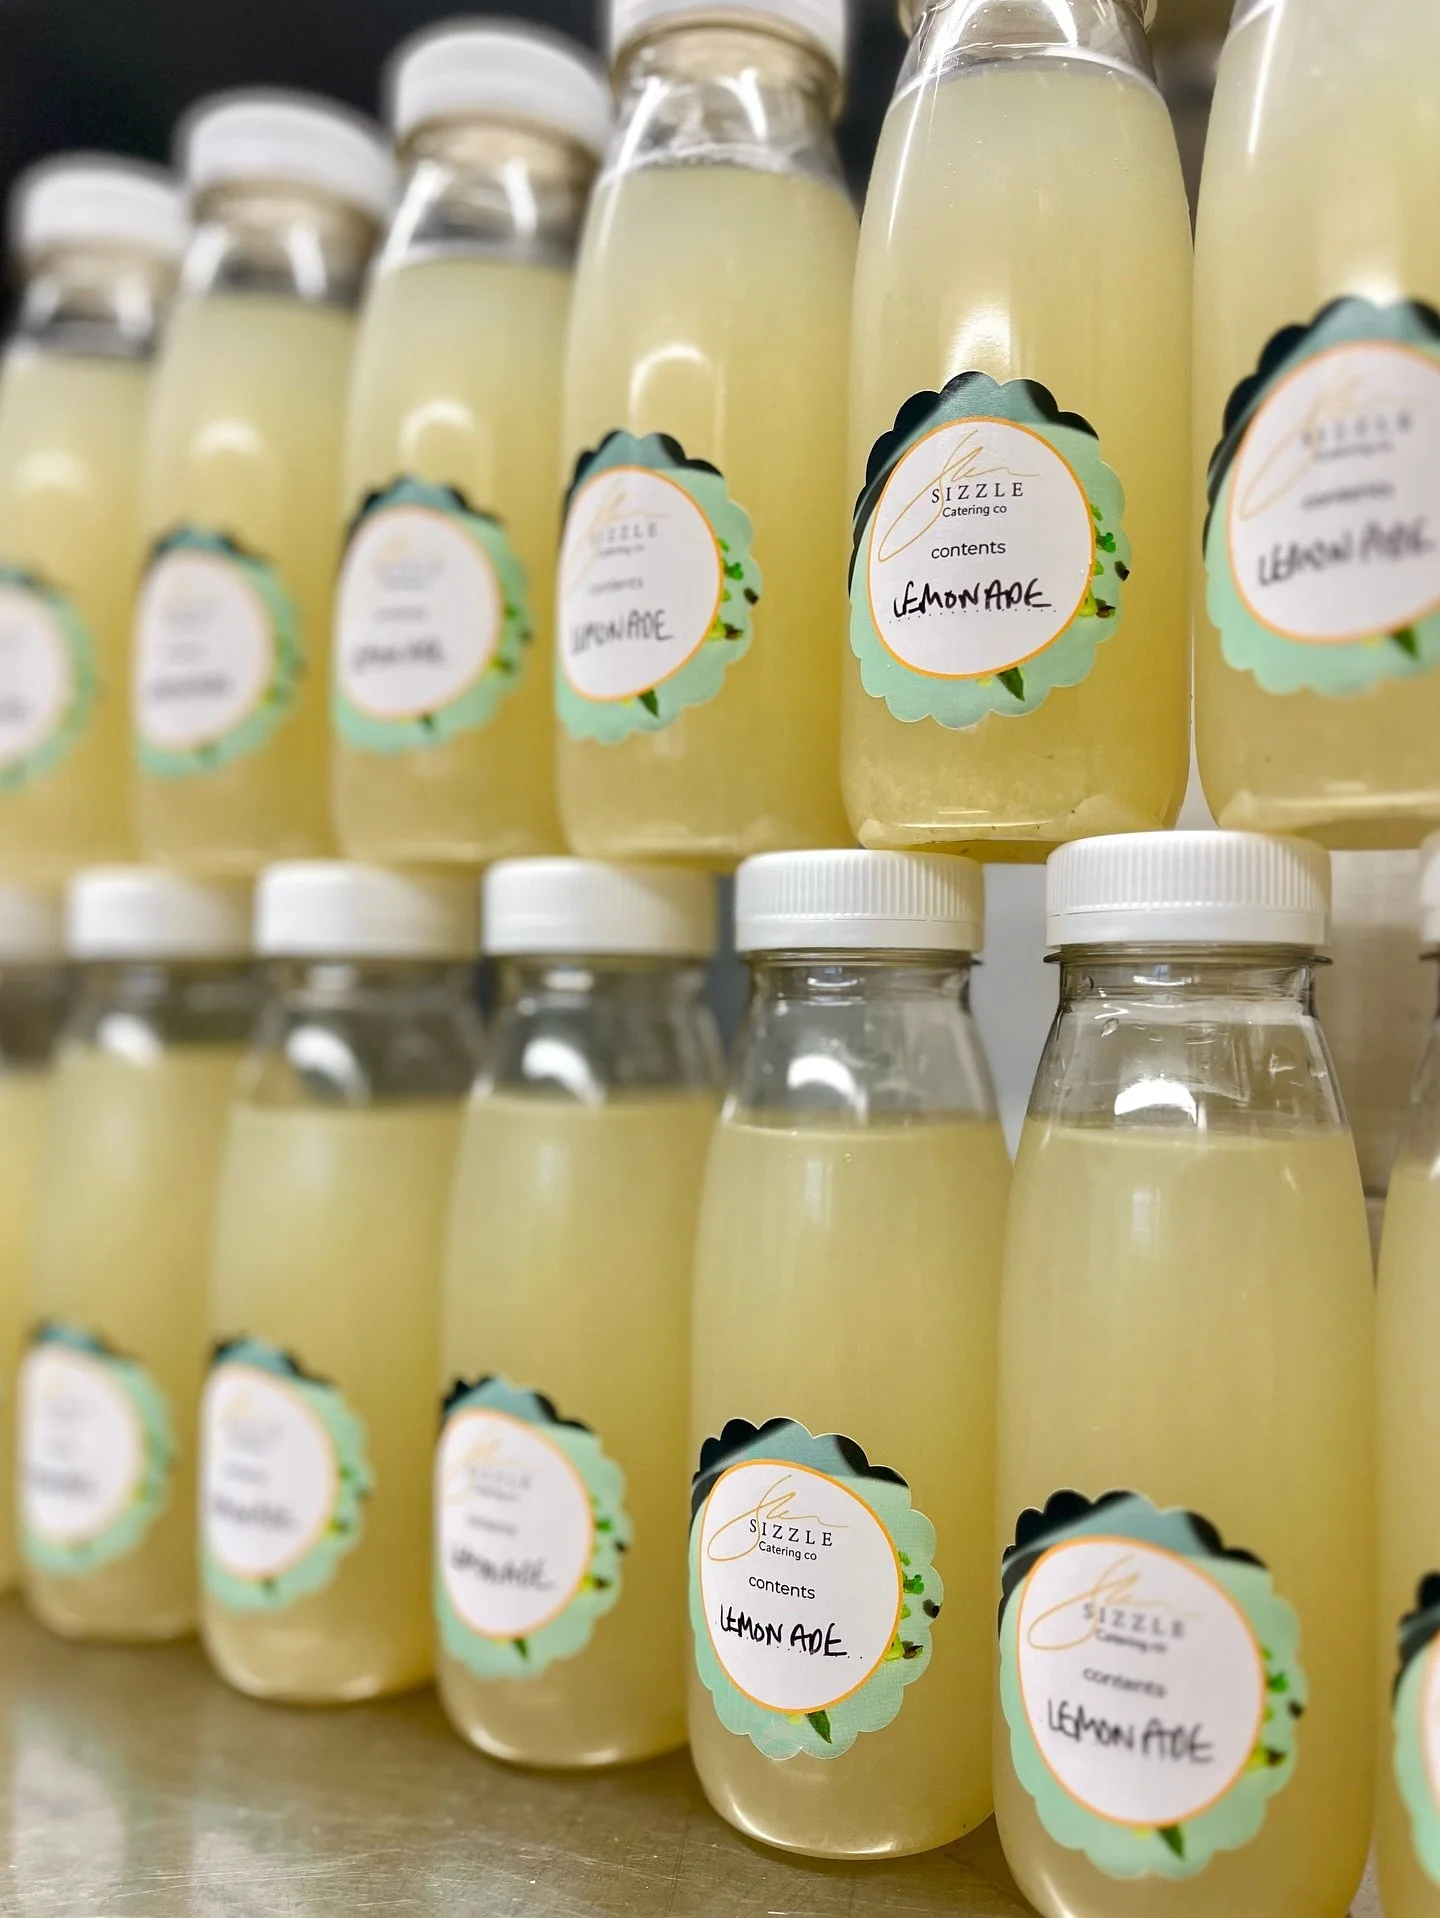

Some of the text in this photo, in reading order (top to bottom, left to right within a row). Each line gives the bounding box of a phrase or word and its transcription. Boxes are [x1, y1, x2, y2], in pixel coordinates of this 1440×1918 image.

[931, 482, 1024, 503] SIZZLE
[942, 504, 1007, 518] Catering co
[931, 540, 1006, 559] contents
[893, 578, 1053, 618] LEMONADE
[749, 1519, 833, 1547] SIZZLE
[758, 1541, 817, 1561] Catering co
[749, 1575, 816, 1600] contents
